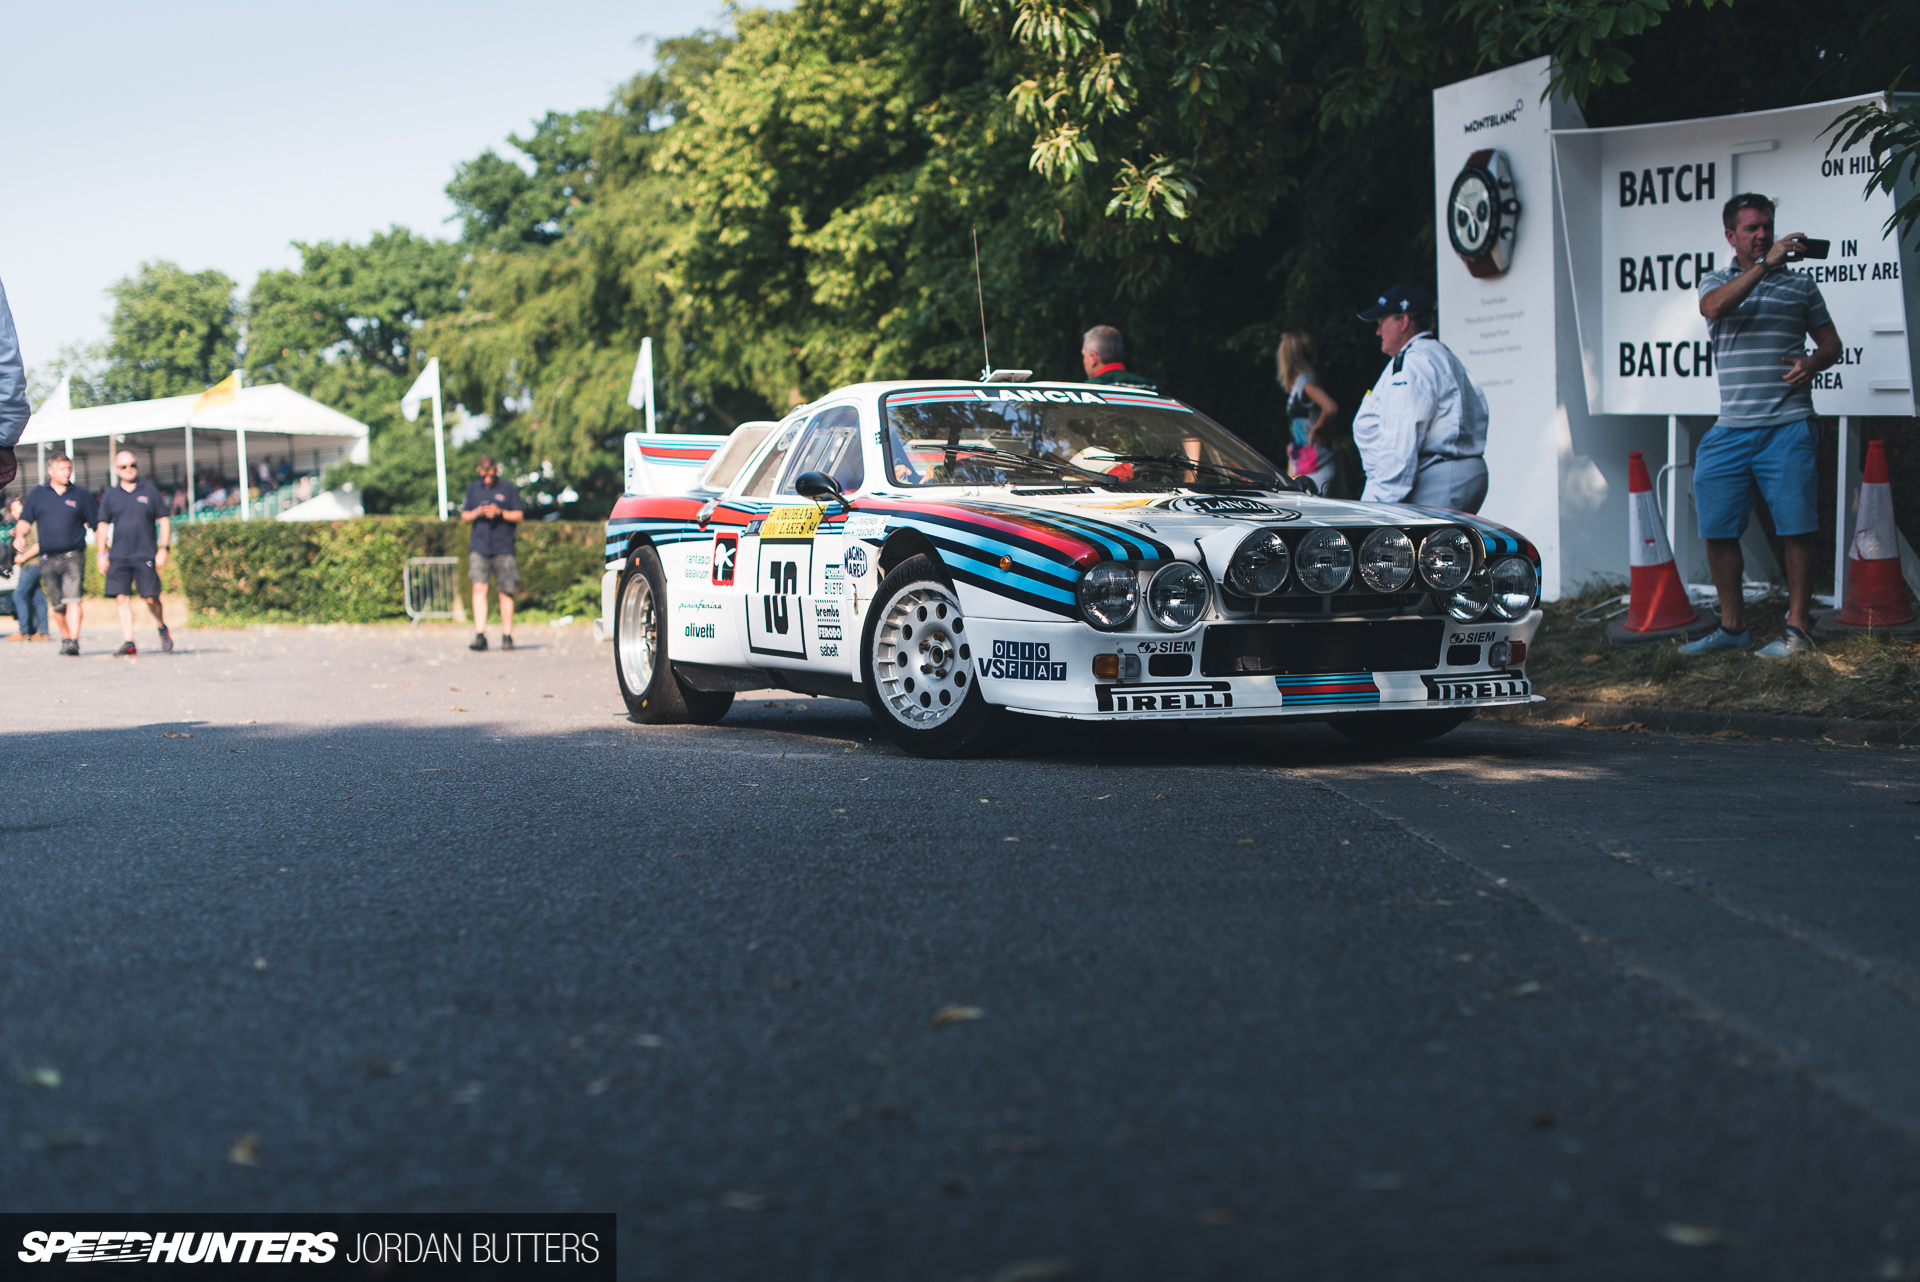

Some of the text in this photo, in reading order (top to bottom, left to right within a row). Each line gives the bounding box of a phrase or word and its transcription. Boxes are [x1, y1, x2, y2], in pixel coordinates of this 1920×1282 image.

[1464, 108, 1517, 133] MONTBLANC
[1821, 156, 1878, 177] ON HIL
[1619, 162, 1716, 208] BATCH
[1841, 239, 1858, 258] IN
[1619, 341, 1713, 377] BATCH
[1811, 372, 1844, 390] REA
[972, 389, 1107, 405] LANCIA
[1204, 499, 1271, 512] LANCIA
[762, 521, 818, 535] 1000 LAKES 84
[815, 604, 839, 617] brembo
[685, 622, 715, 639] olivetti
[818, 626, 842, 639] FERODO
[1466, 631, 1496, 643] SIEM
[820, 643, 839, 657] sabelt
[994, 641, 1049, 660] OLIO
[1158, 641, 1196, 653] SIEM
[978, 658, 1065, 679] VS FIAT
[1420, 669, 1530, 700] PIRELLI
[1094, 681, 1234, 712] PIRELLI
